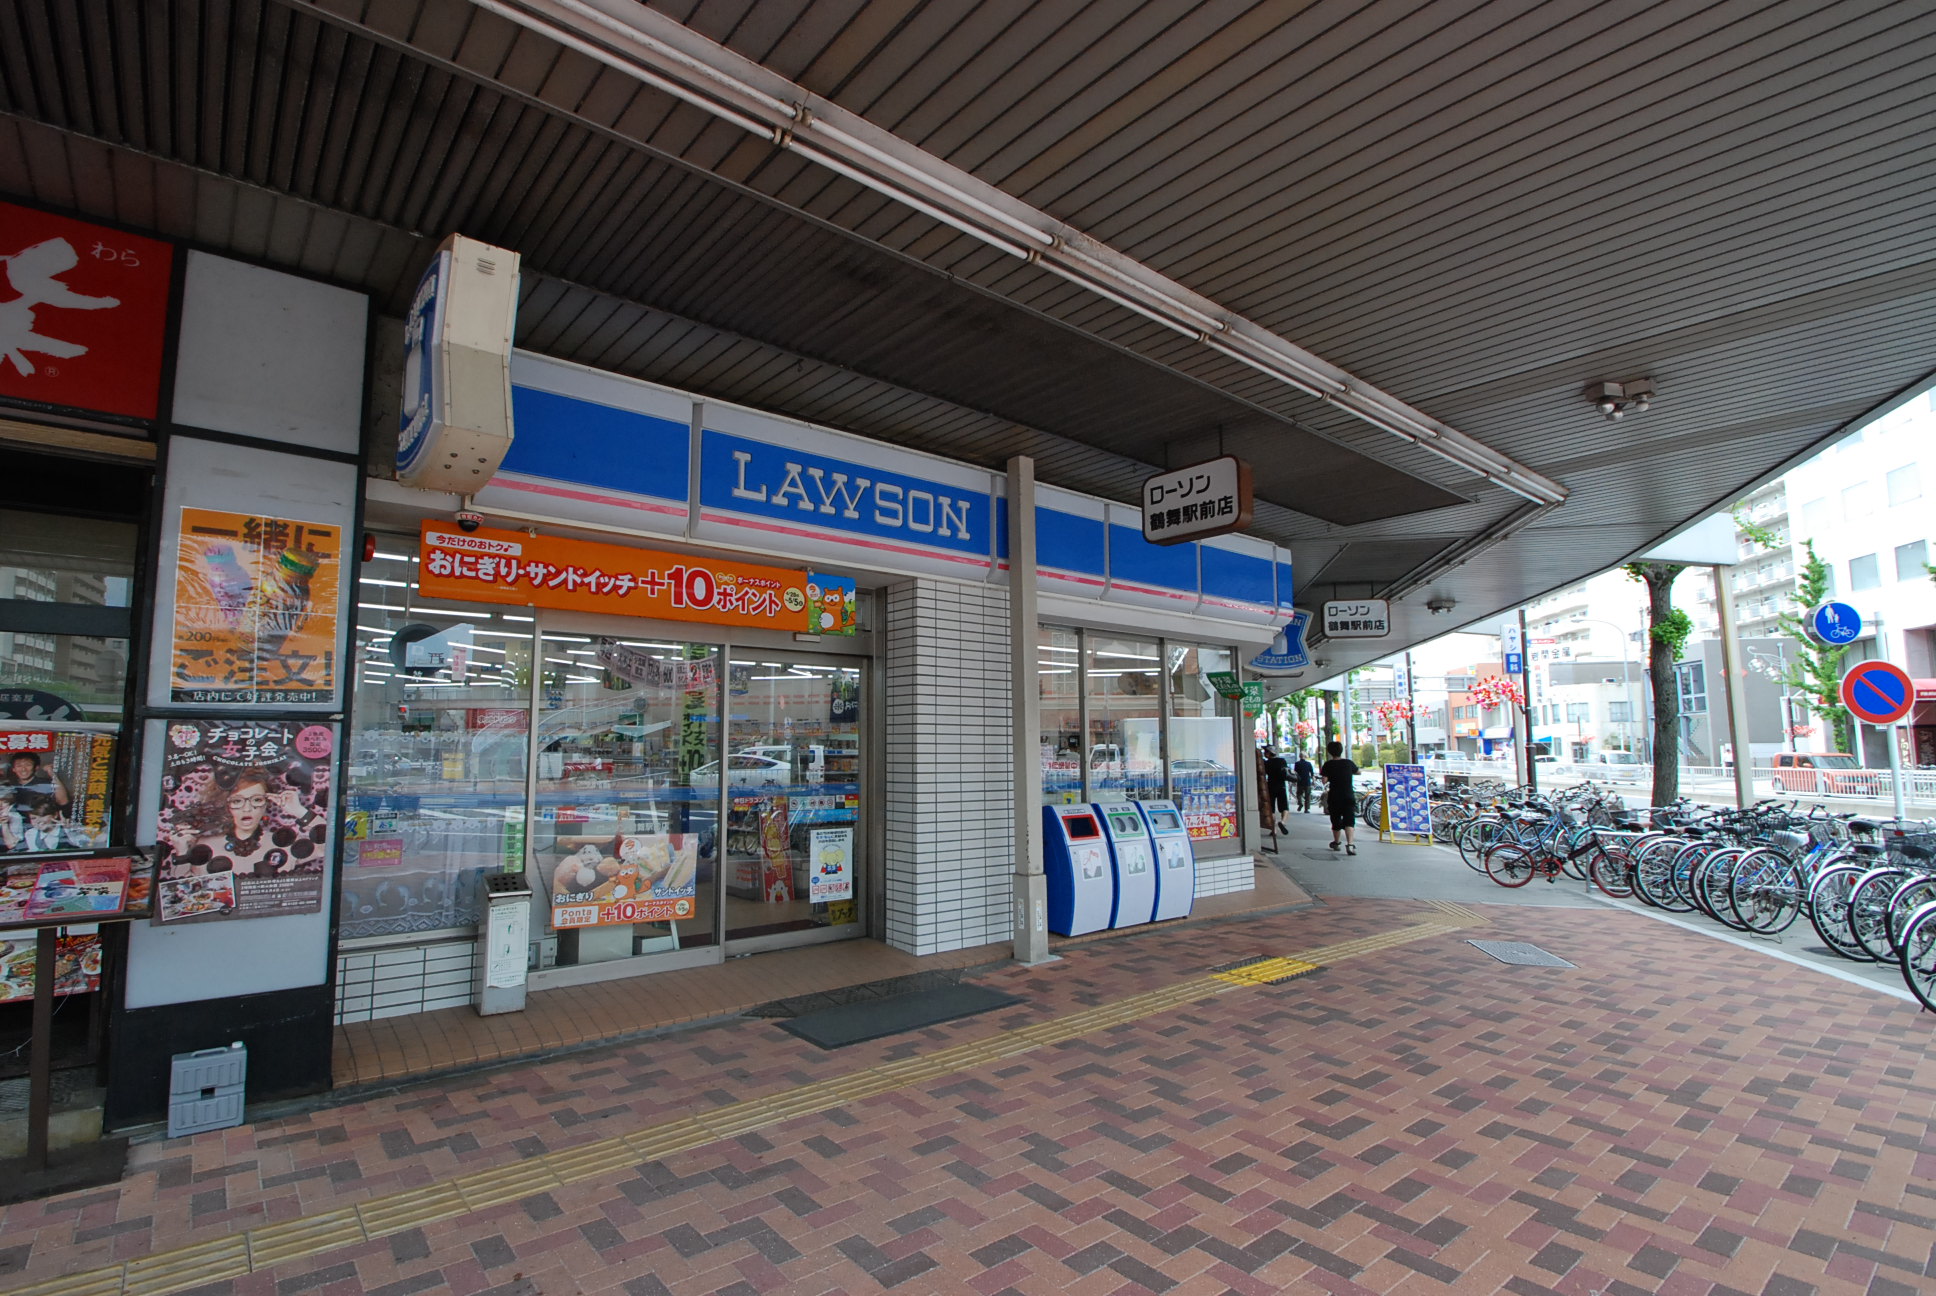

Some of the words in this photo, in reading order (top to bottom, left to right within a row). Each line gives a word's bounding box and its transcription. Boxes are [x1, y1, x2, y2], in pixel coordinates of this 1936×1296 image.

[732, 450, 971, 542] LAWSON
[1150, 474, 1211, 505] ローソン
[1150, 495, 1234, 532] 鶴舞駅前店
[191, 516, 332, 559] 一緒に
[736, 576, 782, 590] ボーナスポイント
[1328, 605, 1370, 617] ローソン
[1328, 619, 1385, 631] 鶴舞駅前店
[1507, 627, 1517, 652] ハヤシ
[1255, 652, 1303, 664] STATION
[207, 727, 294, 745] チョコレート
[222, 741, 279, 760] 女子会
[212, 755, 253, 767] CHOCOLATE
[254, 755, 288, 767] JOSHIKAI
[555, 891, 595, 903] おにぎり
[653, 886, 694, 897] サンドイッチ
[561, 909, 592, 917] Ponta
[561, 915, 591, 925] 会員限定
